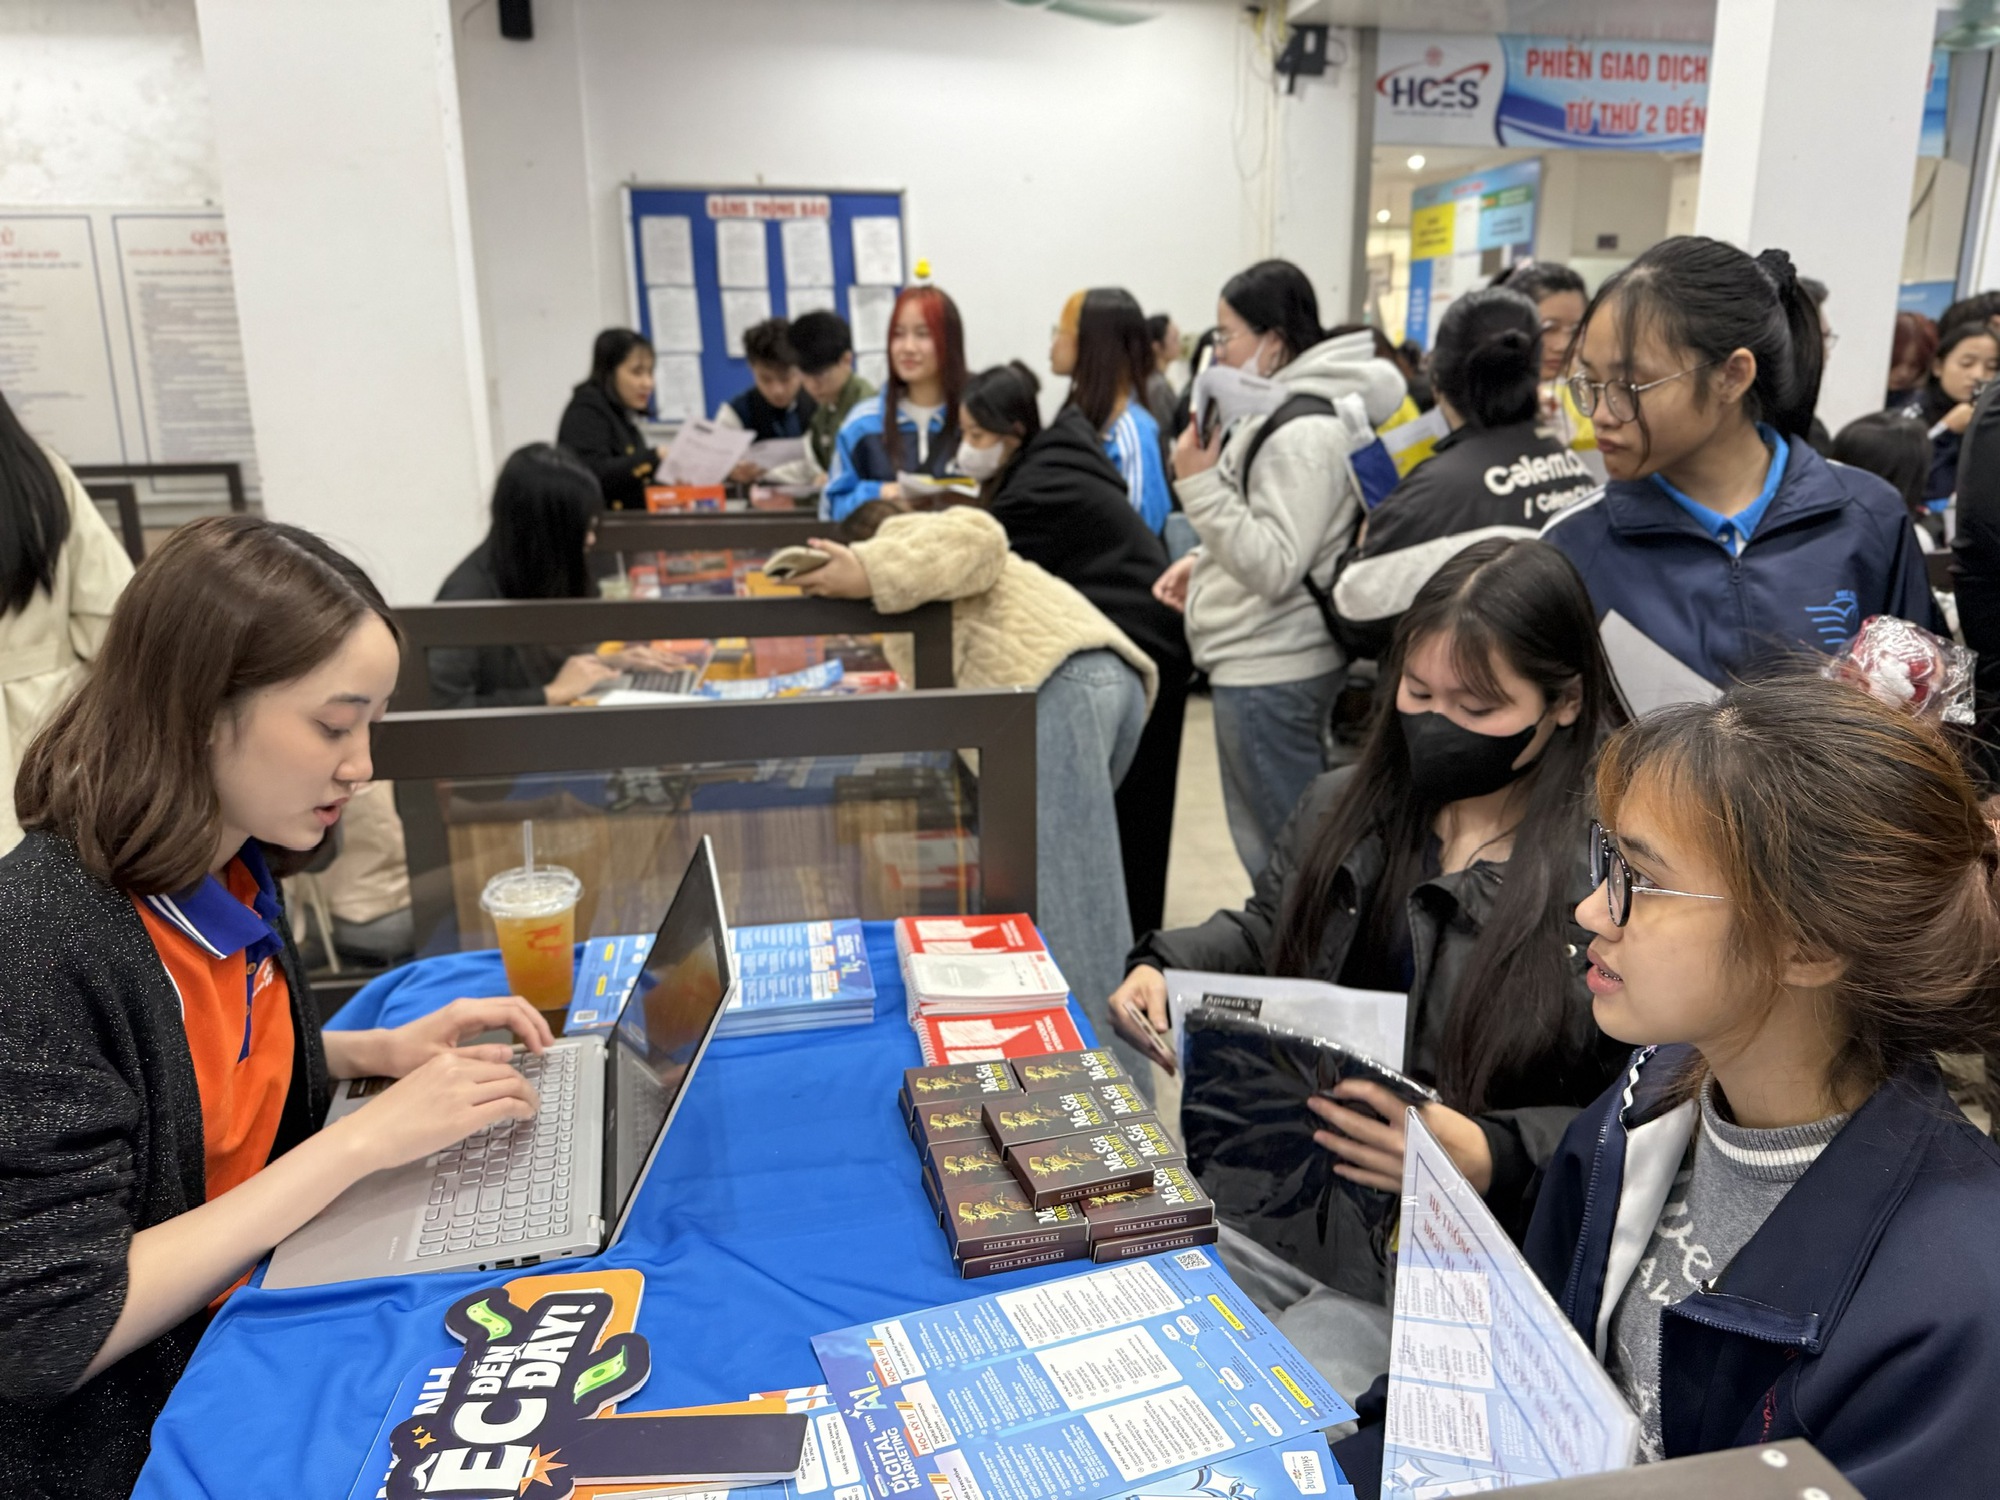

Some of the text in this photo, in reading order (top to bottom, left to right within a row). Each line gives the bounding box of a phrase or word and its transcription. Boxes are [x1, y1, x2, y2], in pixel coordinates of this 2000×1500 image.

[1527, 42, 1708, 90] PHIÊN GIAO DỊCH
[1392, 77, 1479, 109] HCES
[1645, 105, 1658, 133] 2
[1089, 1064, 1109, 1081] Ma
[1105, 1065, 1118, 1079] ONE
[980, 1074, 1000, 1093] Ma
[998, 1079, 1010, 1091] ONE
[1111, 1098, 1132, 1115] Ma
[1126, 1100, 1142, 1112] ONE
[1070, 1109, 1092, 1128] Ma
[1086, 1110, 1102, 1125] ONE
[1137, 1139, 1159, 1158] Ma
[1153, 1141, 1170, 1155] ONE
[1104, 1152, 1128, 1172] Ma
[1120, 1153, 1139, 1168] ONE
[1161, 1186, 1185, 1206] Ma
[1178, 1187, 1196, 1202] ONE
[1035, 1206, 1059, 1224] M
[883, 1326, 897, 1345] marketing
[507, 1304, 596, 1389] ĐÂY!
[876, 1348, 885, 1356] III
[467, 1346, 520, 1395] ĐẾN
[884, 1365, 900, 1382] HỌC
[412, 1367, 457, 1416] NH
[847, 1383, 888, 1432] WITH AI
[916, 1402, 940, 1444] Digital Performance
[932, 1420, 947, 1442] Executive
[411, 1398, 547, 1500] ỆC
[914, 1431, 931, 1450] HỌC
[873, 1430, 904, 1489] DIGITAL
[886, 1426, 922, 1488] MARKETING
[951, 1467, 967, 1491] Executive
[1301, 1455, 1316, 1490] skillking
